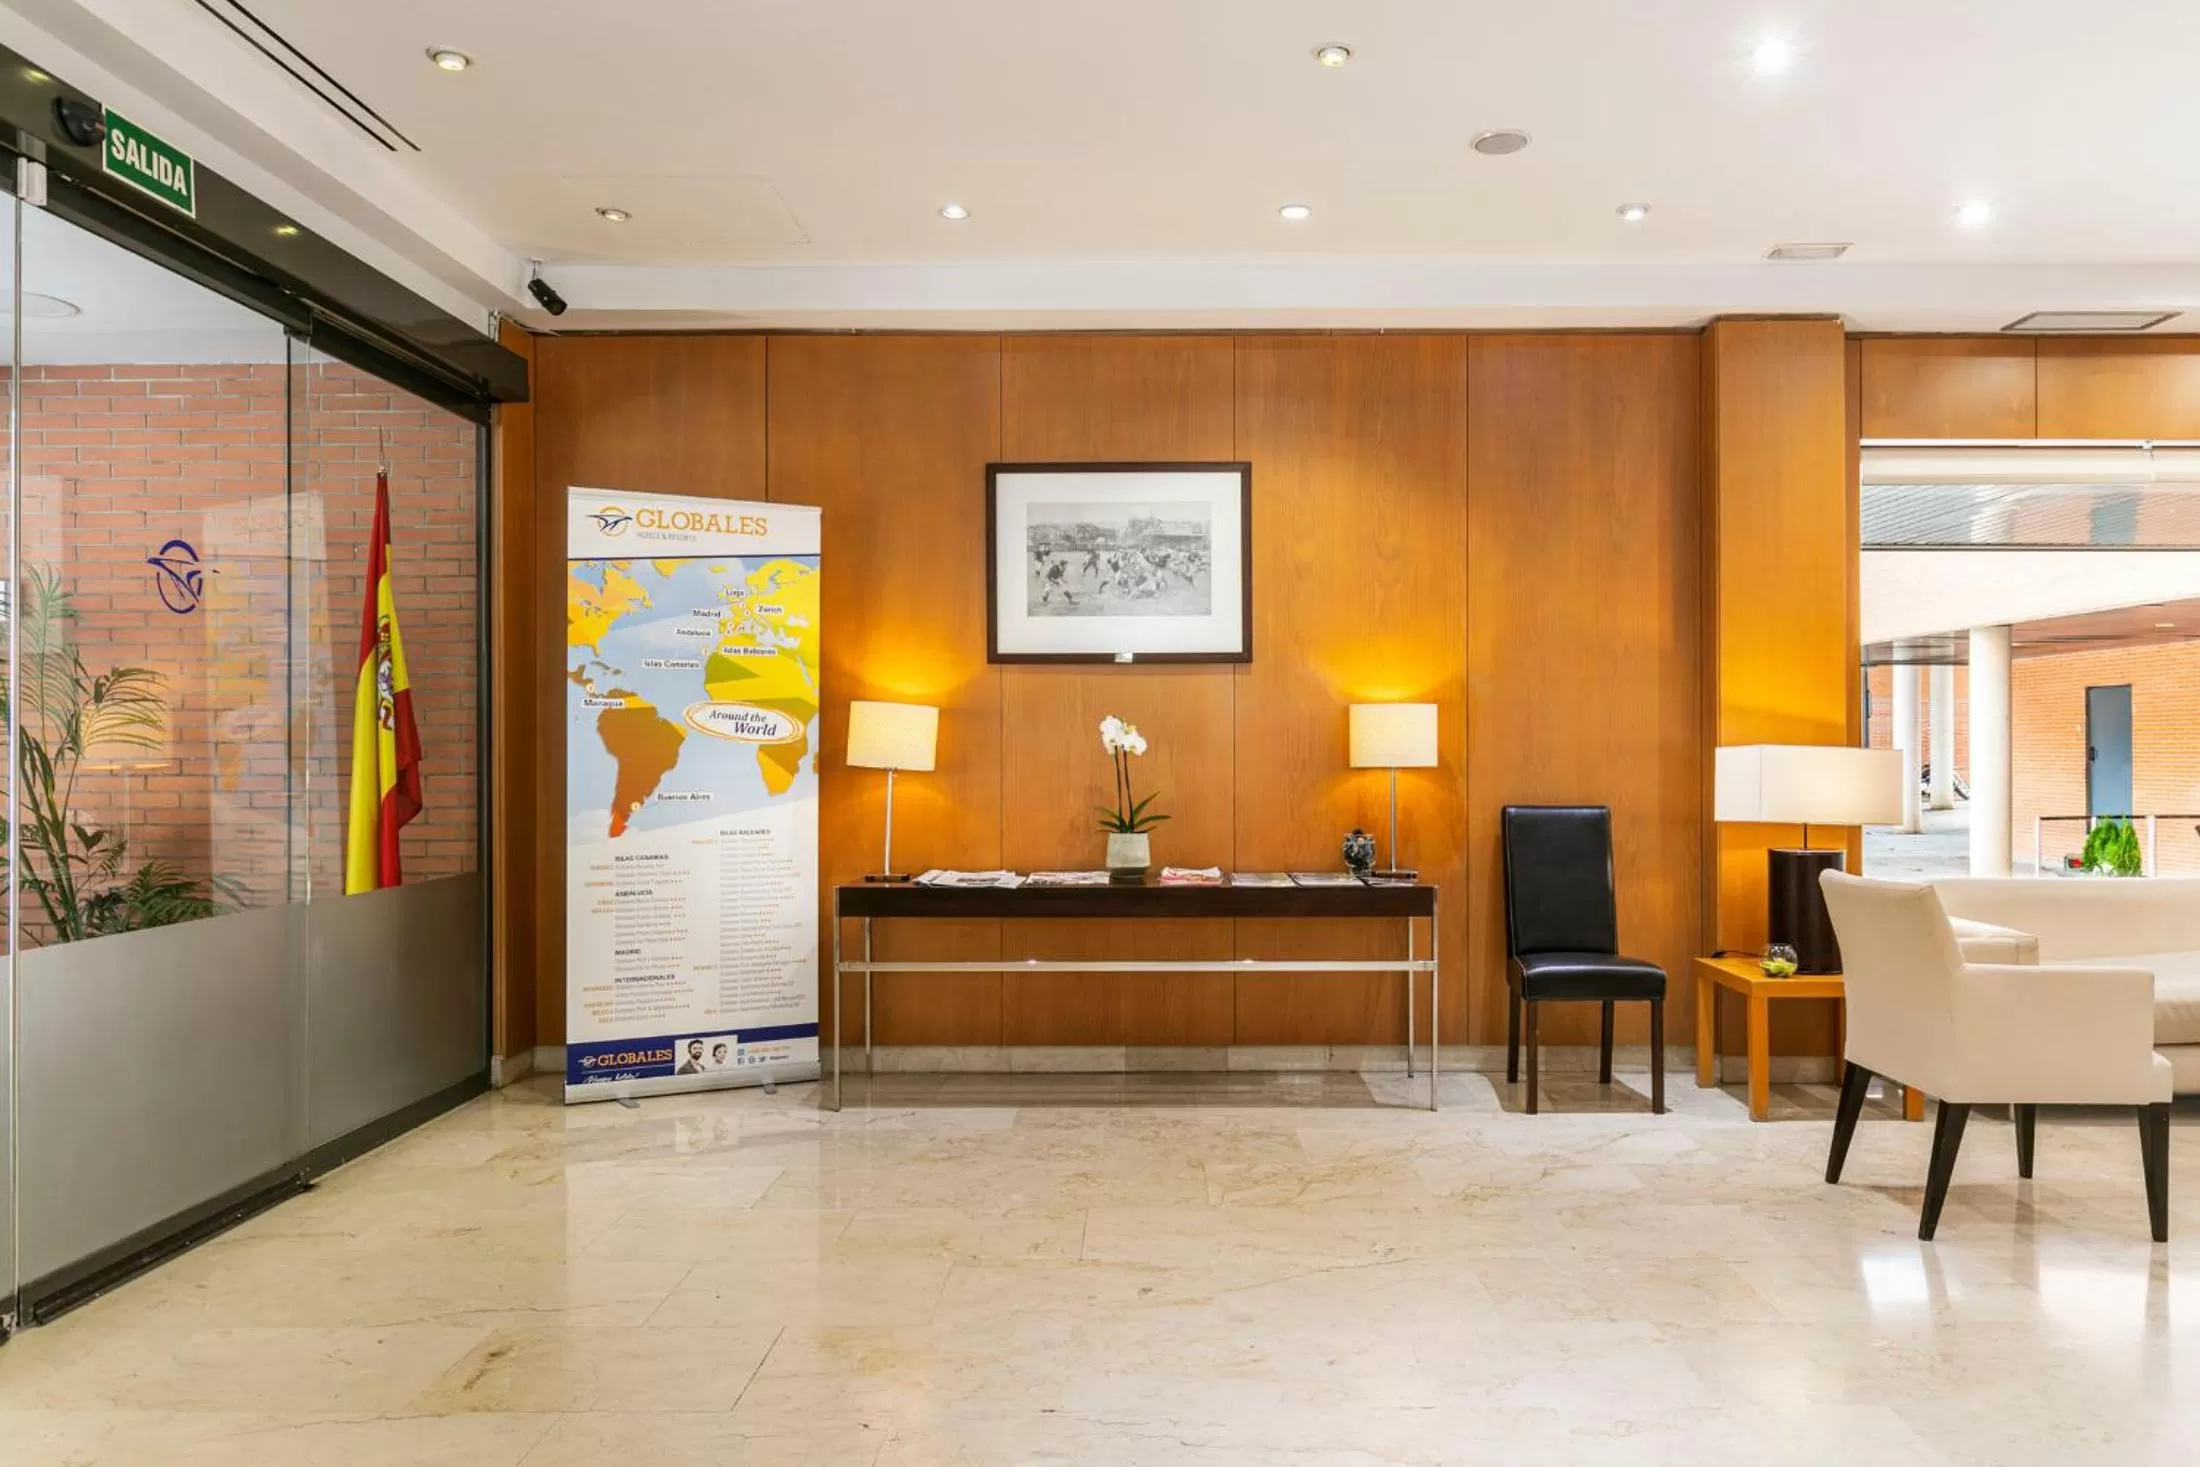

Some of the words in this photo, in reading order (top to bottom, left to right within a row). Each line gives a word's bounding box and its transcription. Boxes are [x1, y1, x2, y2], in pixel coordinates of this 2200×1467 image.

[111, 128, 188, 197] SALIDA
[635, 508, 768, 537] GLOBALES
[692, 609, 721, 618] Madrid
[644, 660, 662, 668] Islas
[664, 660, 700, 669] Canarias
[583, 698, 624, 708] Managua
[708, 709, 749, 722] Around
[750, 711, 767, 722] the
[733, 721, 778, 737] World
[657, 792, 688, 801] Buenos
[690, 793, 711, 801] Aires
[597, 1048, 673, 1067] GLOBALES
